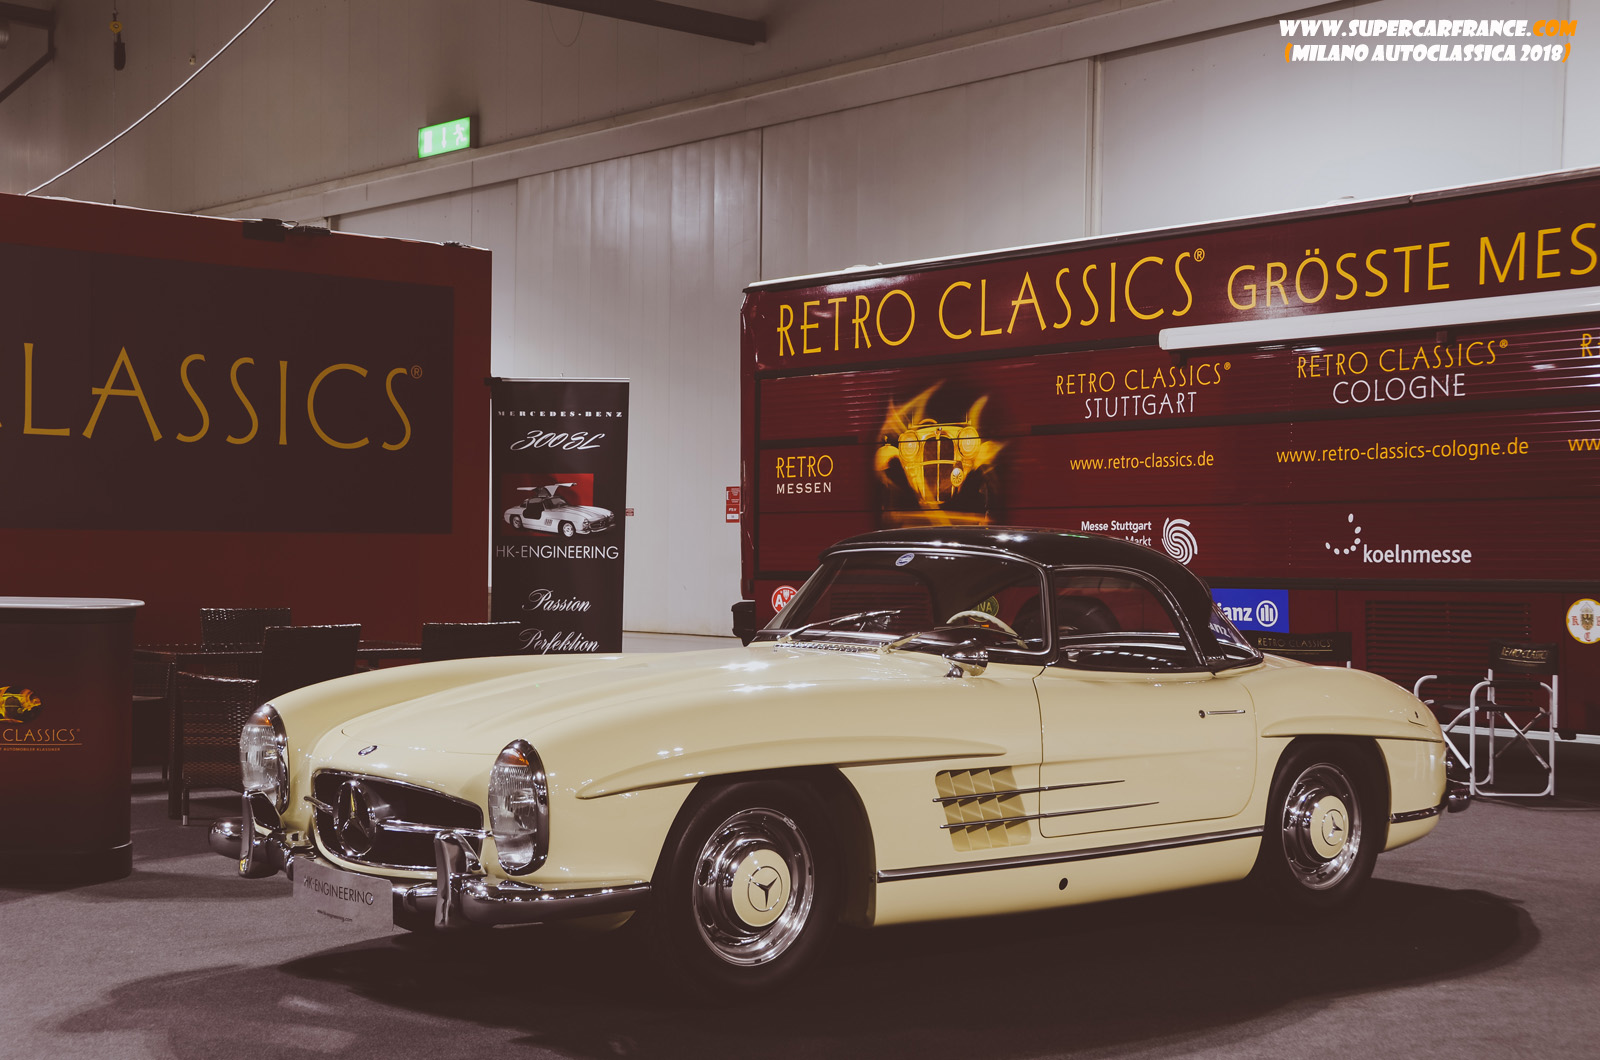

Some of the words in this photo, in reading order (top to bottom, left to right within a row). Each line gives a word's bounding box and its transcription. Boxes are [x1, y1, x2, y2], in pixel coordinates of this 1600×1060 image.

[777, 289, 916, 356] RETRO
[1227, 241, 1450, 310] GRÖSSTE
[1296, 351, 1369, 378] RETRO
[1056, 371, 1116, 395] RETRO
[1332, 373, 1466, 404] COLOGNE
[0, 341, 423, 452] LASSICS®
[1085, 391, 1197, 419] STUTTGART
[1070, 450, 1214, 470] www.retro-classics.de
[1276, 436, 1529, 462] www.retro-classics-cologne.de
[775, 454, 834, 479] RETRO
[776, 481, 832, 495] MESSEN
[1081, 520, 1109, 531] Messe
[1110, 520, 1152, 533] Stuttgart
[496, 545, 619, 560] HK-ENGINEERING
[1363, 543, 1472, 563] koelnmesse
[521, 588, 591, 612] Passion
[519, 627, 599, 655] Perfektion
[1257, 637, 1286, 648] RETRO
